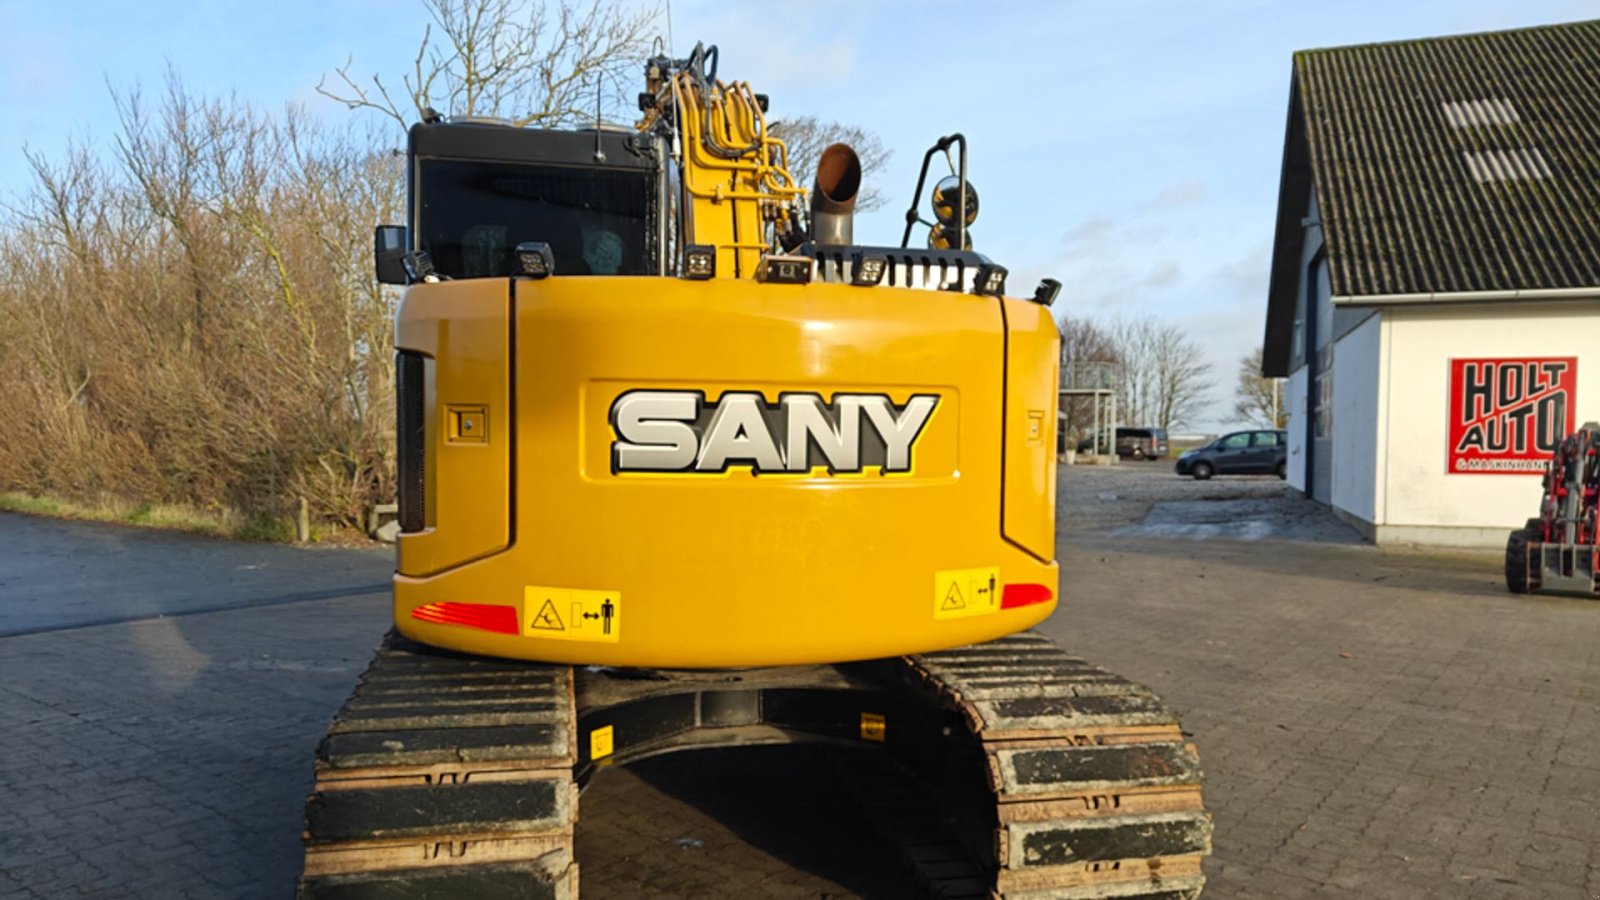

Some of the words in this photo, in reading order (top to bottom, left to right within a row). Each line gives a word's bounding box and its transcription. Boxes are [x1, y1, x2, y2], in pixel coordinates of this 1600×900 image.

[1456, 389, 1567, 452] AUTO
[1463, 363, 1567, 424] HOLT
[610, 390, 941, 474] SANY
